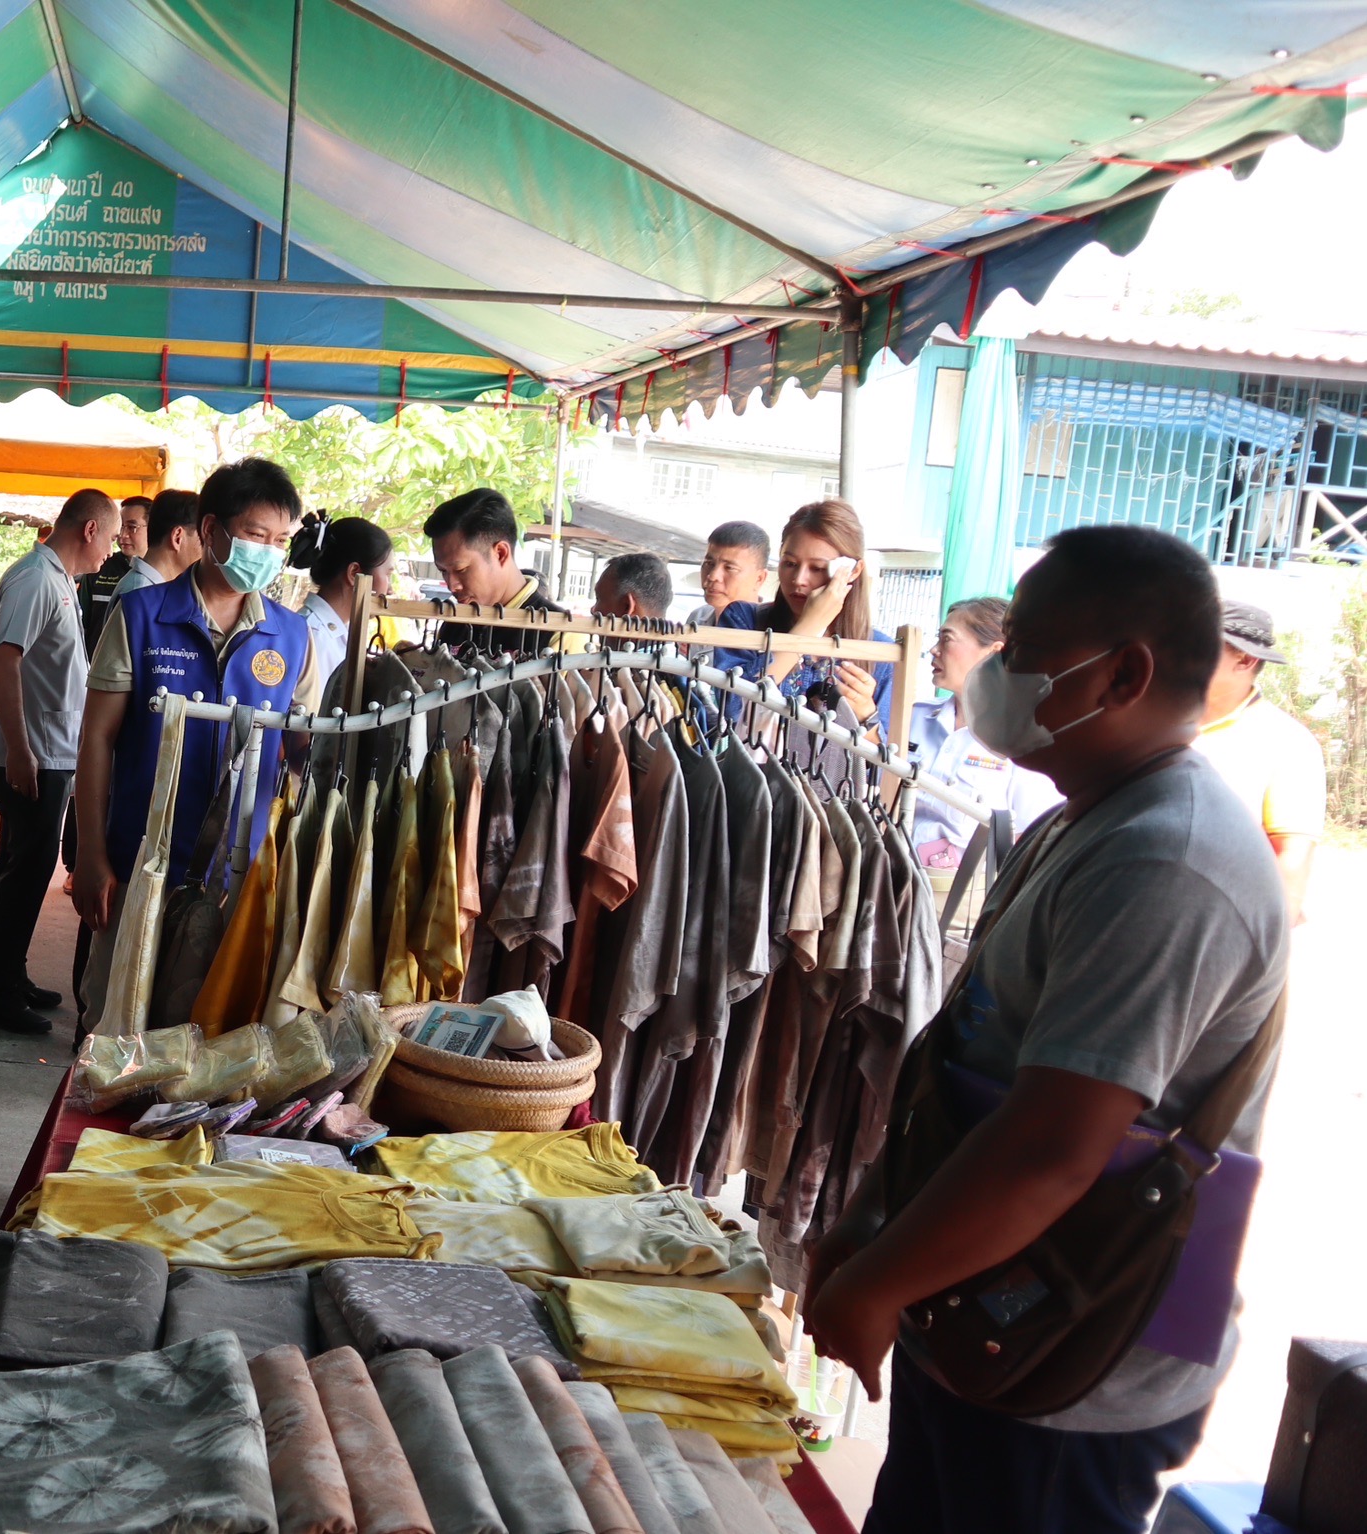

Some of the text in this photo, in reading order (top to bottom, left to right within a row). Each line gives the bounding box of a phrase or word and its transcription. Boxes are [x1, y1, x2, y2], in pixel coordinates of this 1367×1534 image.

[111, 181, 133, 198] 40
[103, 205, 162, 224] ฉายแสง
[151, 664, 186, 676] ปลัดอำเภอ
